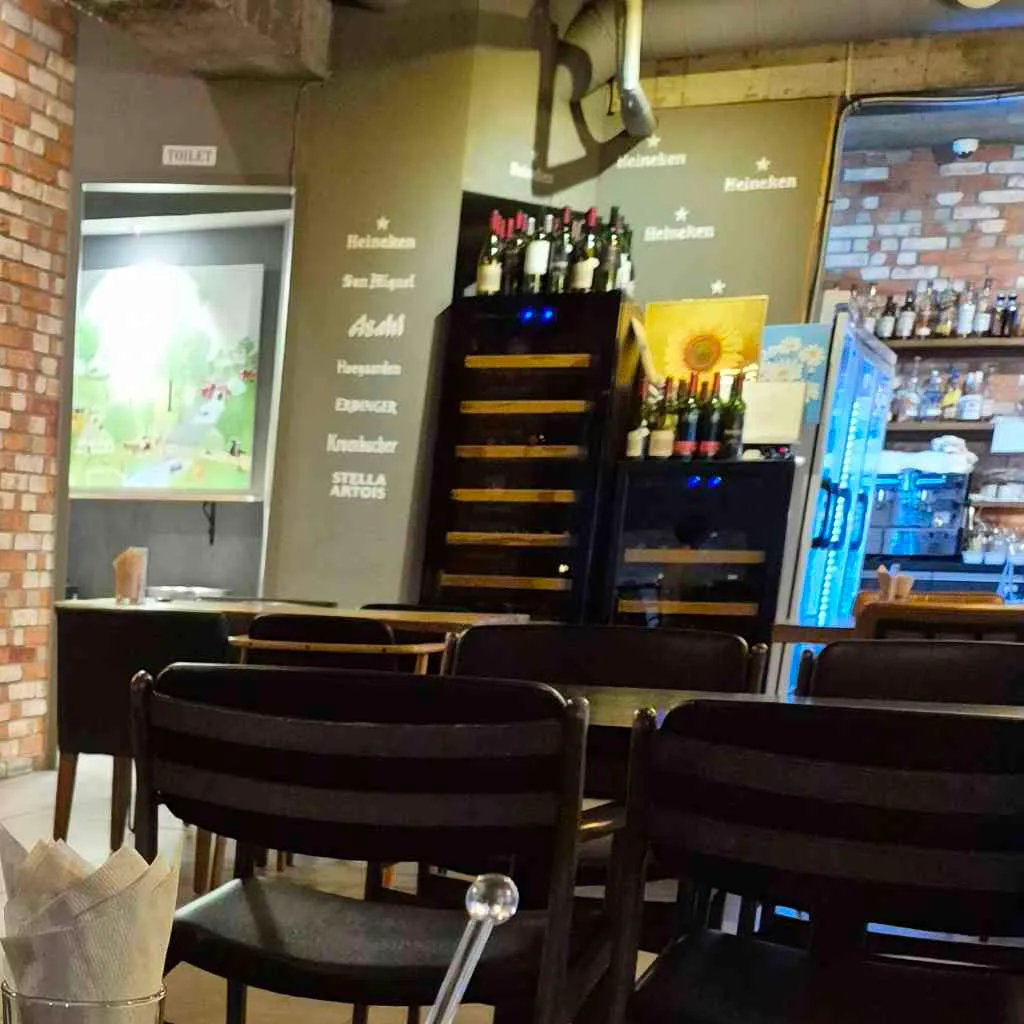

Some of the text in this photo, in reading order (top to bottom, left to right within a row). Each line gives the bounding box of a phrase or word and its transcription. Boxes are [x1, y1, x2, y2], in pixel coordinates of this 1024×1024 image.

[167, 149, 211, 162] TOILET
[724, 175, 798, 192] Heineken
[644, 225, 715, 242] Heineken
[346, 234, 416, 249] Heineken
[347, 313, 407, 338] Asahi
[331, 472, 387, 486] STELLA
[329, 486, 386, 500] ARTOIS
